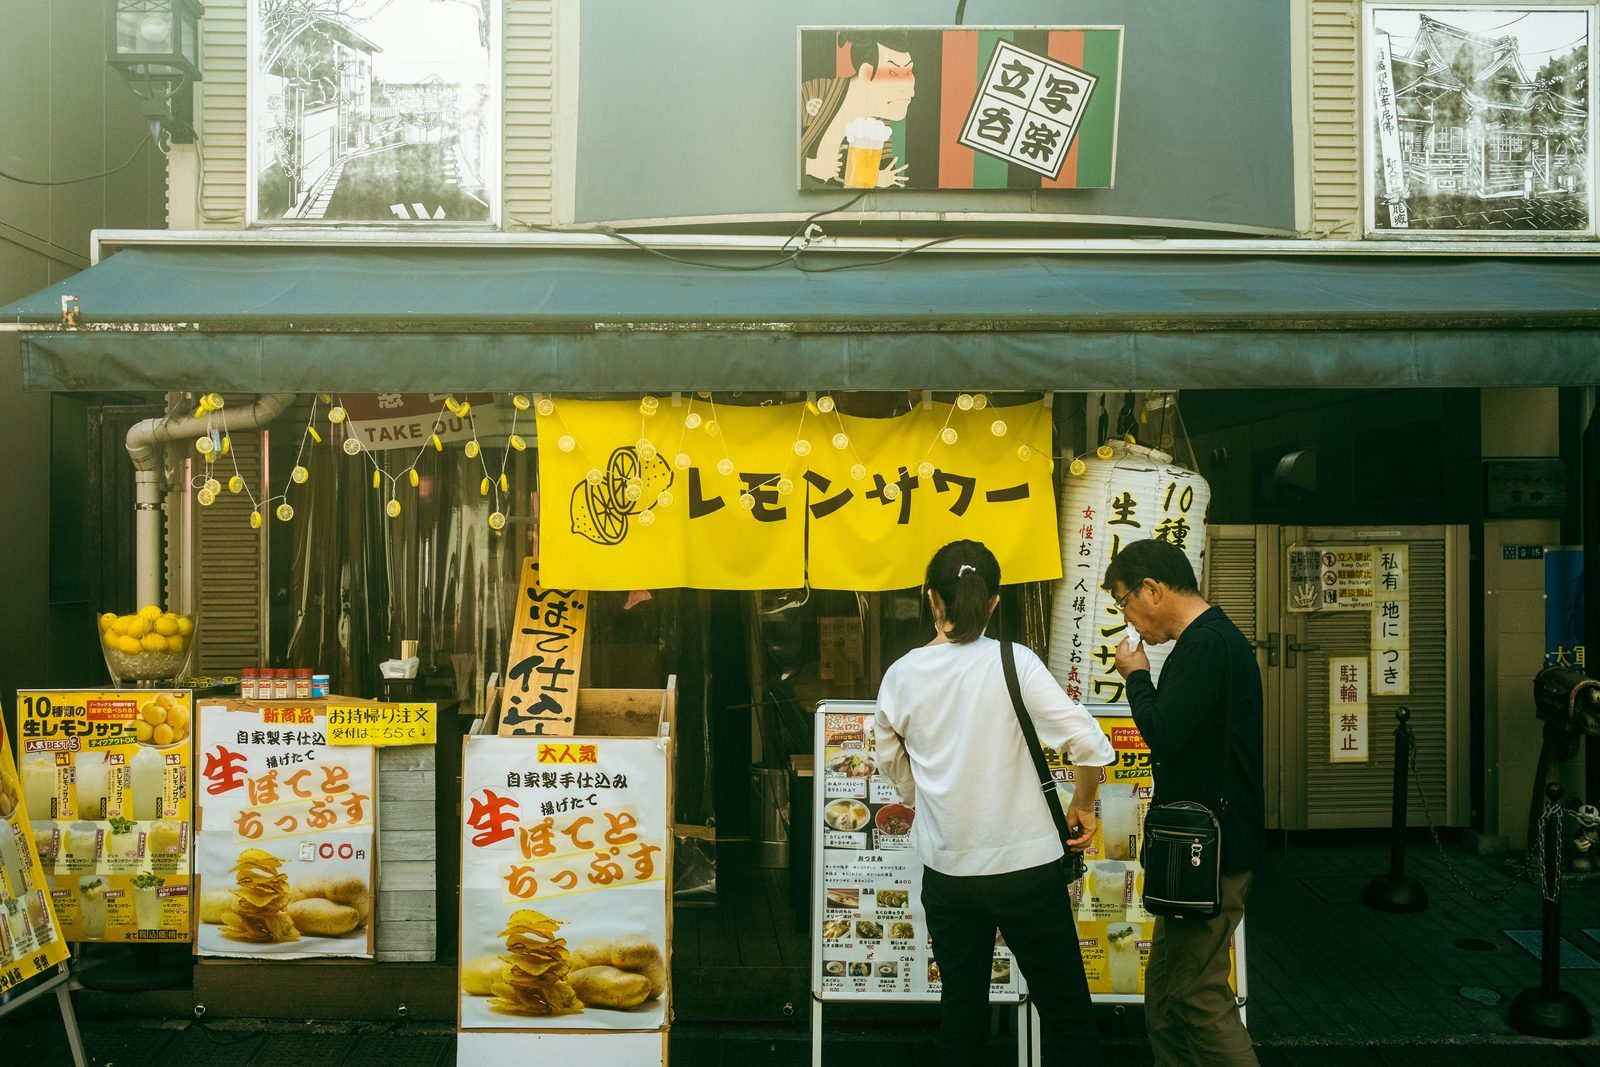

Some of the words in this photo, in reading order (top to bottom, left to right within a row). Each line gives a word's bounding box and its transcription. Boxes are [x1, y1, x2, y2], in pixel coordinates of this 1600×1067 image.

[364, 423, 423, 443] TAKE
[431, 414, 477, 436] OUT
[688, 465, 1031, 525] レモンサワー
[1337, 552, 1372, 562] 立入禁止
[1338, 569, 1373, 579] 駐輪禁止
[1381, 552, 1400, 685] 私有地につき
[23, 696, 86, 719] 10種類の
[263, 708, 315, 723] 新商品
[328, 707, 431, 725] お持帰り注文
[1340, 664, 1359, 752] 駐輪禁止
[23, 719, 137, 737] 生レモンサワー
[331, 728, 417, 739] 受付はこちらで
[266, 749, 315, 769] 揚げたて
[538, 745, 597, 763] 大人気
[202, 745, 249, 796] 生
[507, 771, 629, 790] 自家製手仕込み
[247, 765, 353, 806] ぽてと
[540, 792, 598, 816] 揚げたて
[233, 793, 370, 840] ちっぷす
[467, 788, 521, 848] 生
[518, 811, 639, 860] ぽてと
[503, 842, 662, 899] ちっぷす
